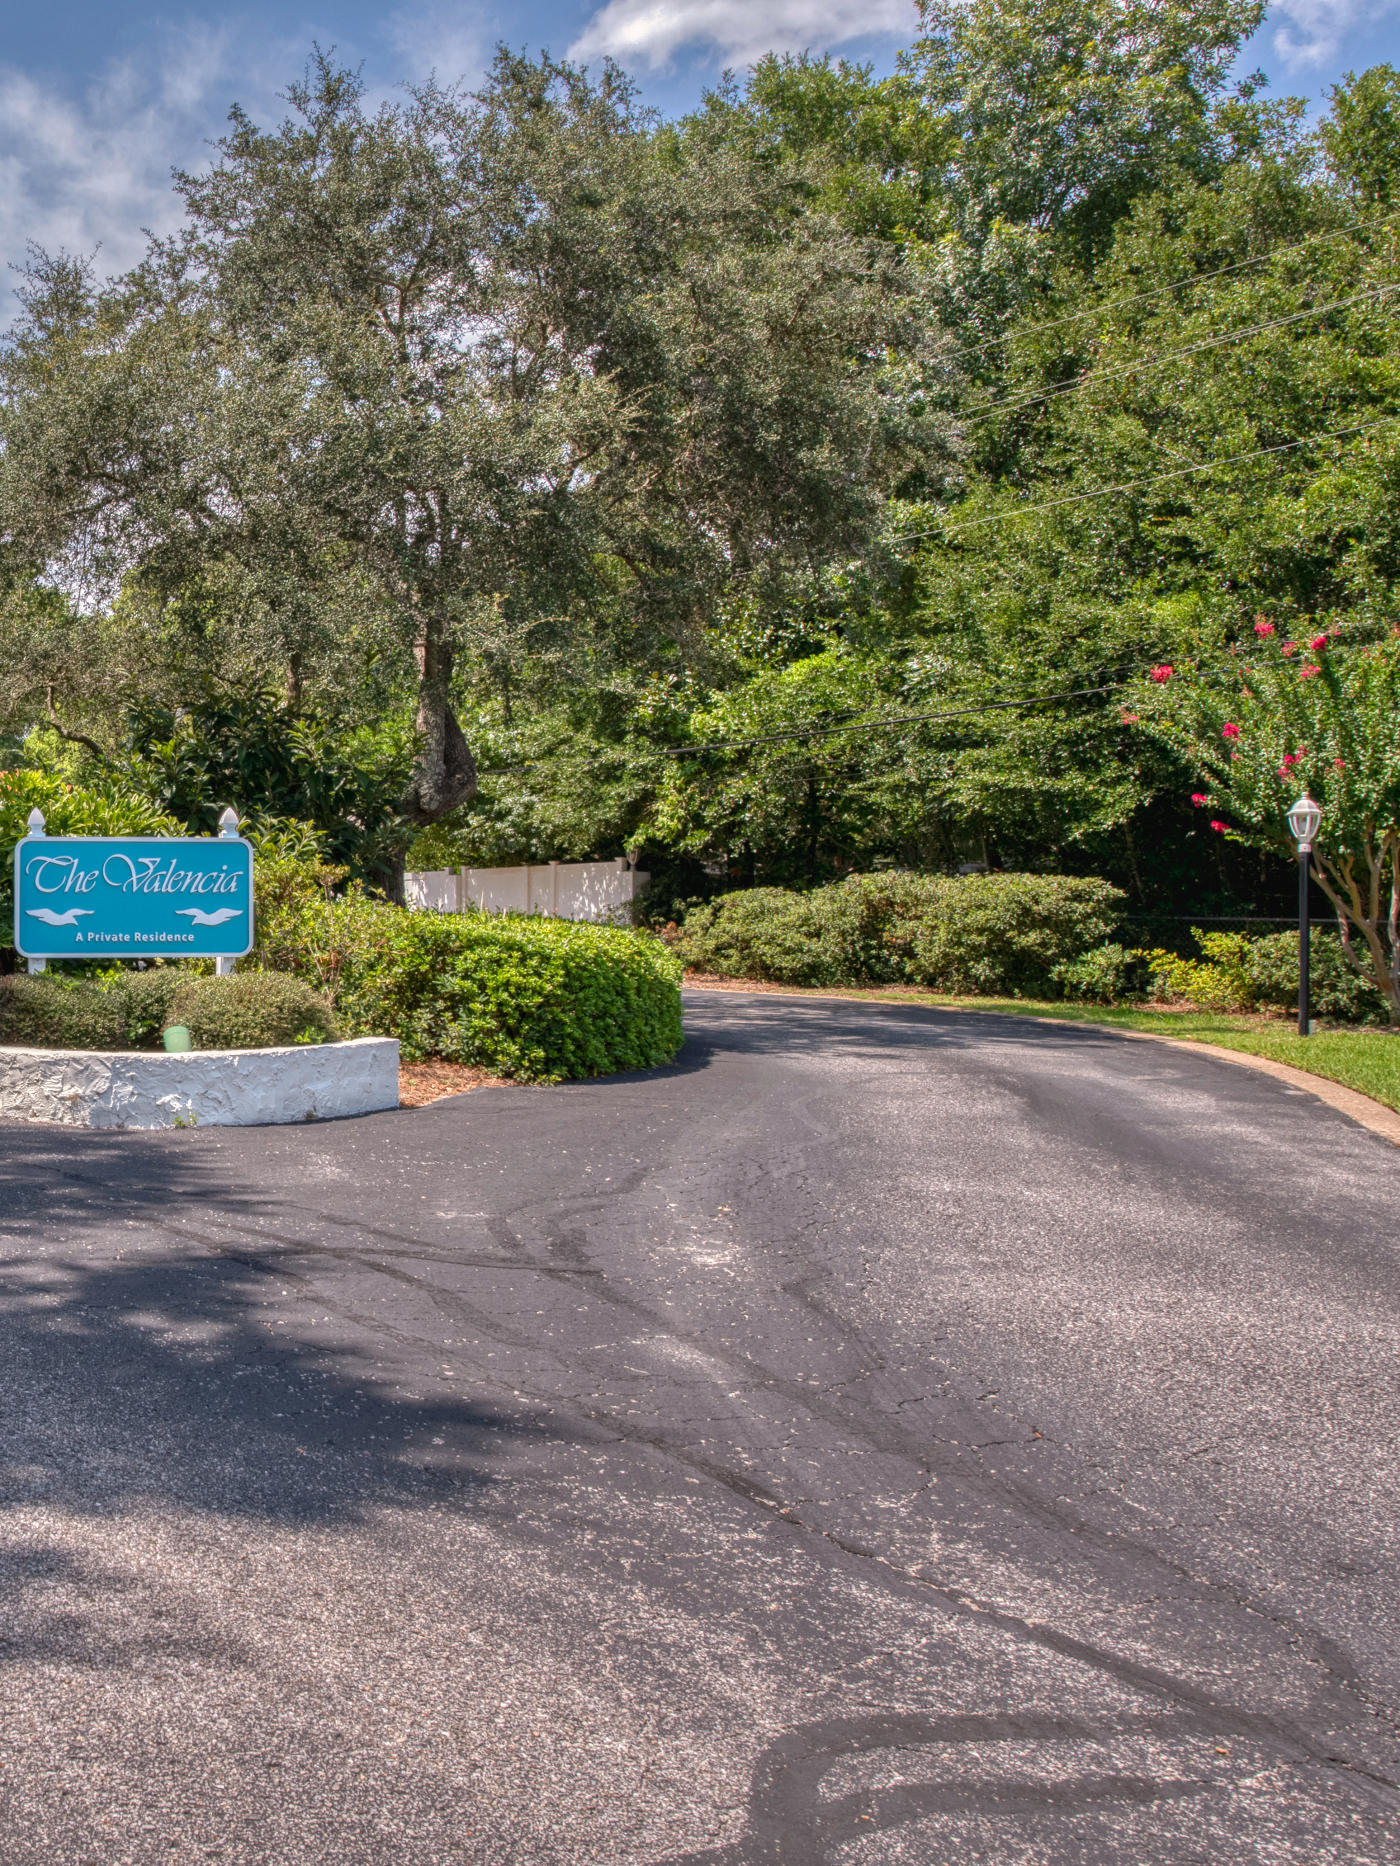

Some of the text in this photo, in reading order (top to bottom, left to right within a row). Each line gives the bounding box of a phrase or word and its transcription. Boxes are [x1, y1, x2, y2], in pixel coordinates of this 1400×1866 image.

[25, 853, 244, 894] The Valencia
[75, 931, 195, 943] A Private Residence
